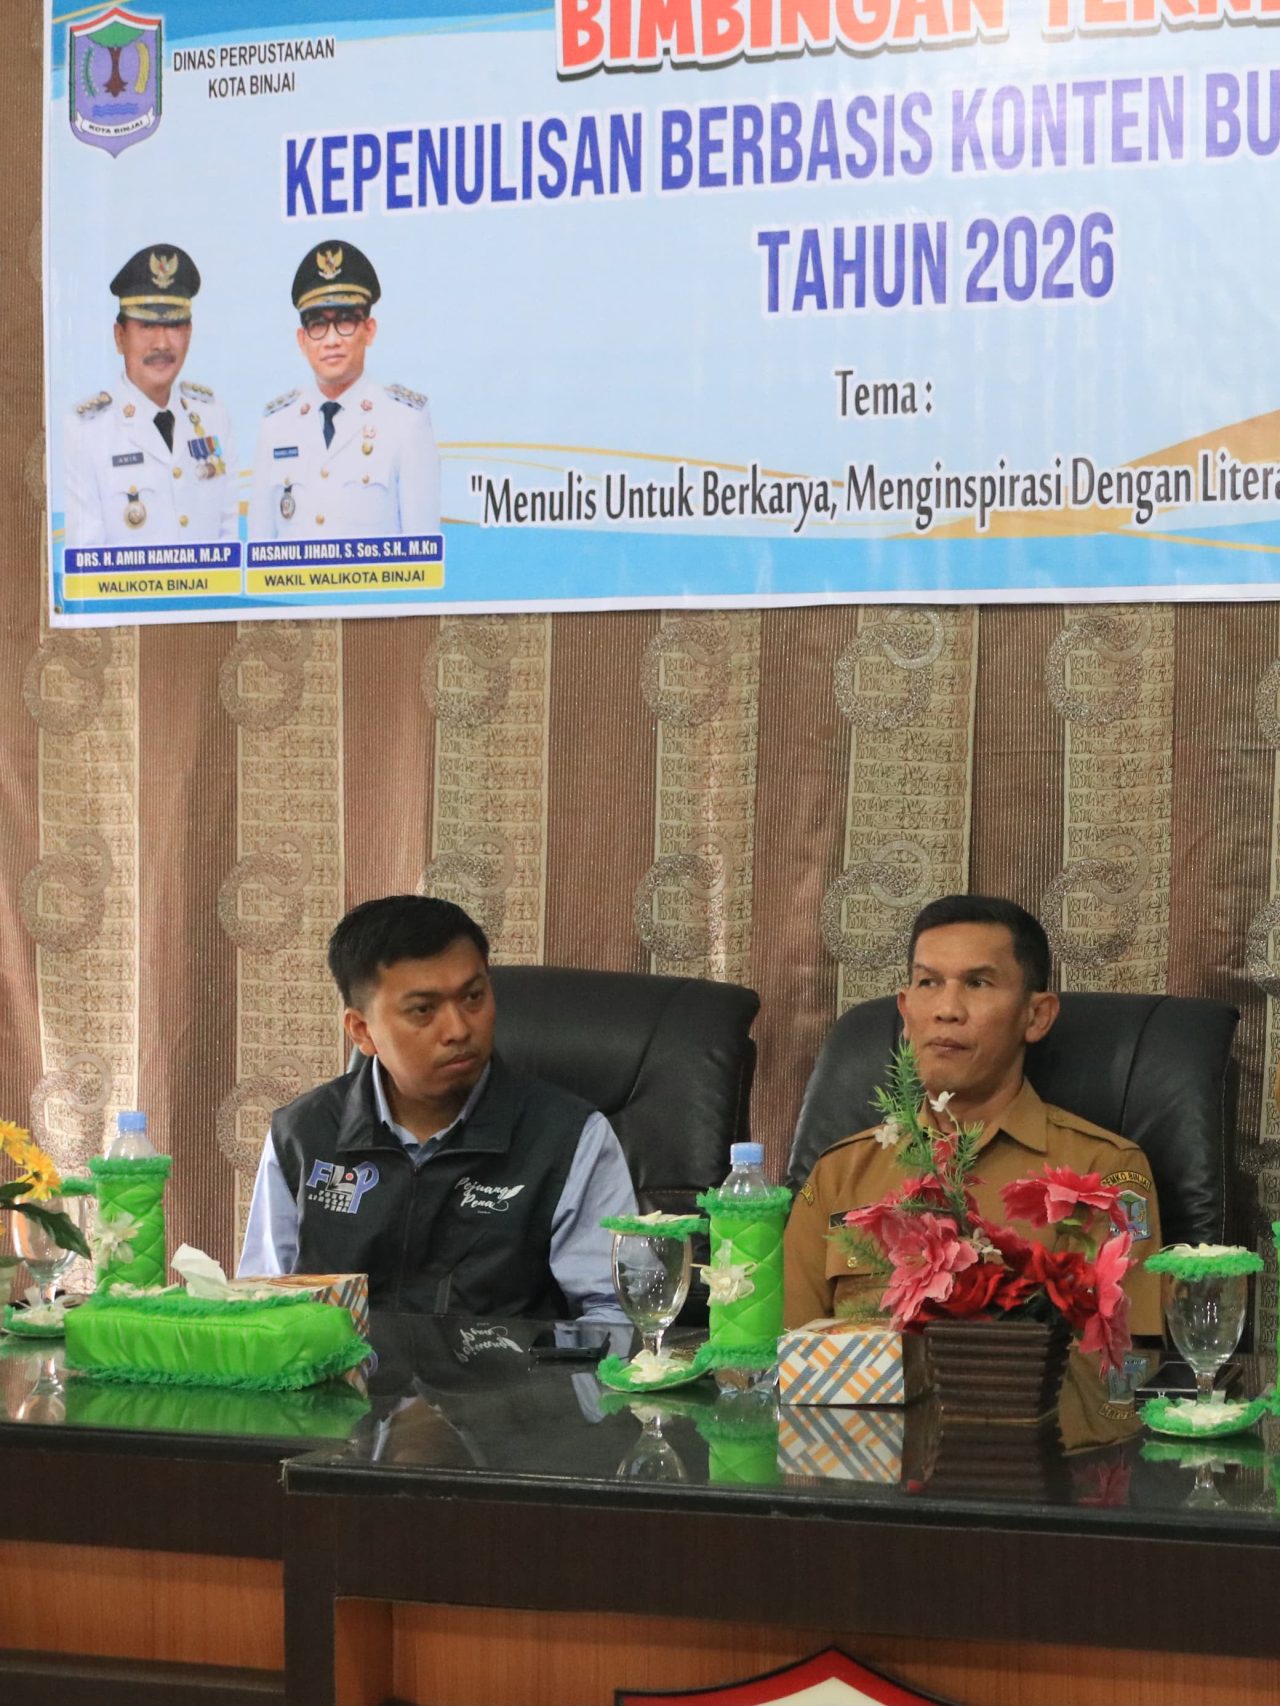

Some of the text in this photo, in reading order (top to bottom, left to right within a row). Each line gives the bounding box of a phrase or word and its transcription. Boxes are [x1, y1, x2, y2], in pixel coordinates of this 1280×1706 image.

[173, 38, 335, 72] DINAS PERPUSTAKAAN
[208, 72, 295, 98] KOTA BINJAI
[88, 120, 144, 134] KOTA BINJAI
[286, 113, 642, 217] KEPENULISAN
[661, 91, 933, 191] BERBASIS
[951, 75, 1184, 173] KONTEN
[757, 212, 1115, 313] TAHUN 2026
[834, 370, 918, 416] Tema
[470, 470, 597, 525] "Menulis
[605, 467, 694, 519] Untuk
[703, 464, 837, 533] Berkarya,
[846, 457, 1062, 530] Menginspirasi
[1071, 456, 1192, 524] Dengan
[76, 547, 231, 568] DRS. H. AMIR HAMZAH, M.A.P
[251, 545, 302, 562] HASANUL
[304, 544, 343, 560] JIHADI,
[345, 544, 354, 558] S.
[408, 540, 437, 556] M.Kn
[98, 578, 208, 593] WALIKOTA BINJAI
[264, 570, 425, 587] WAKIL WALIKOTA BINJAI
